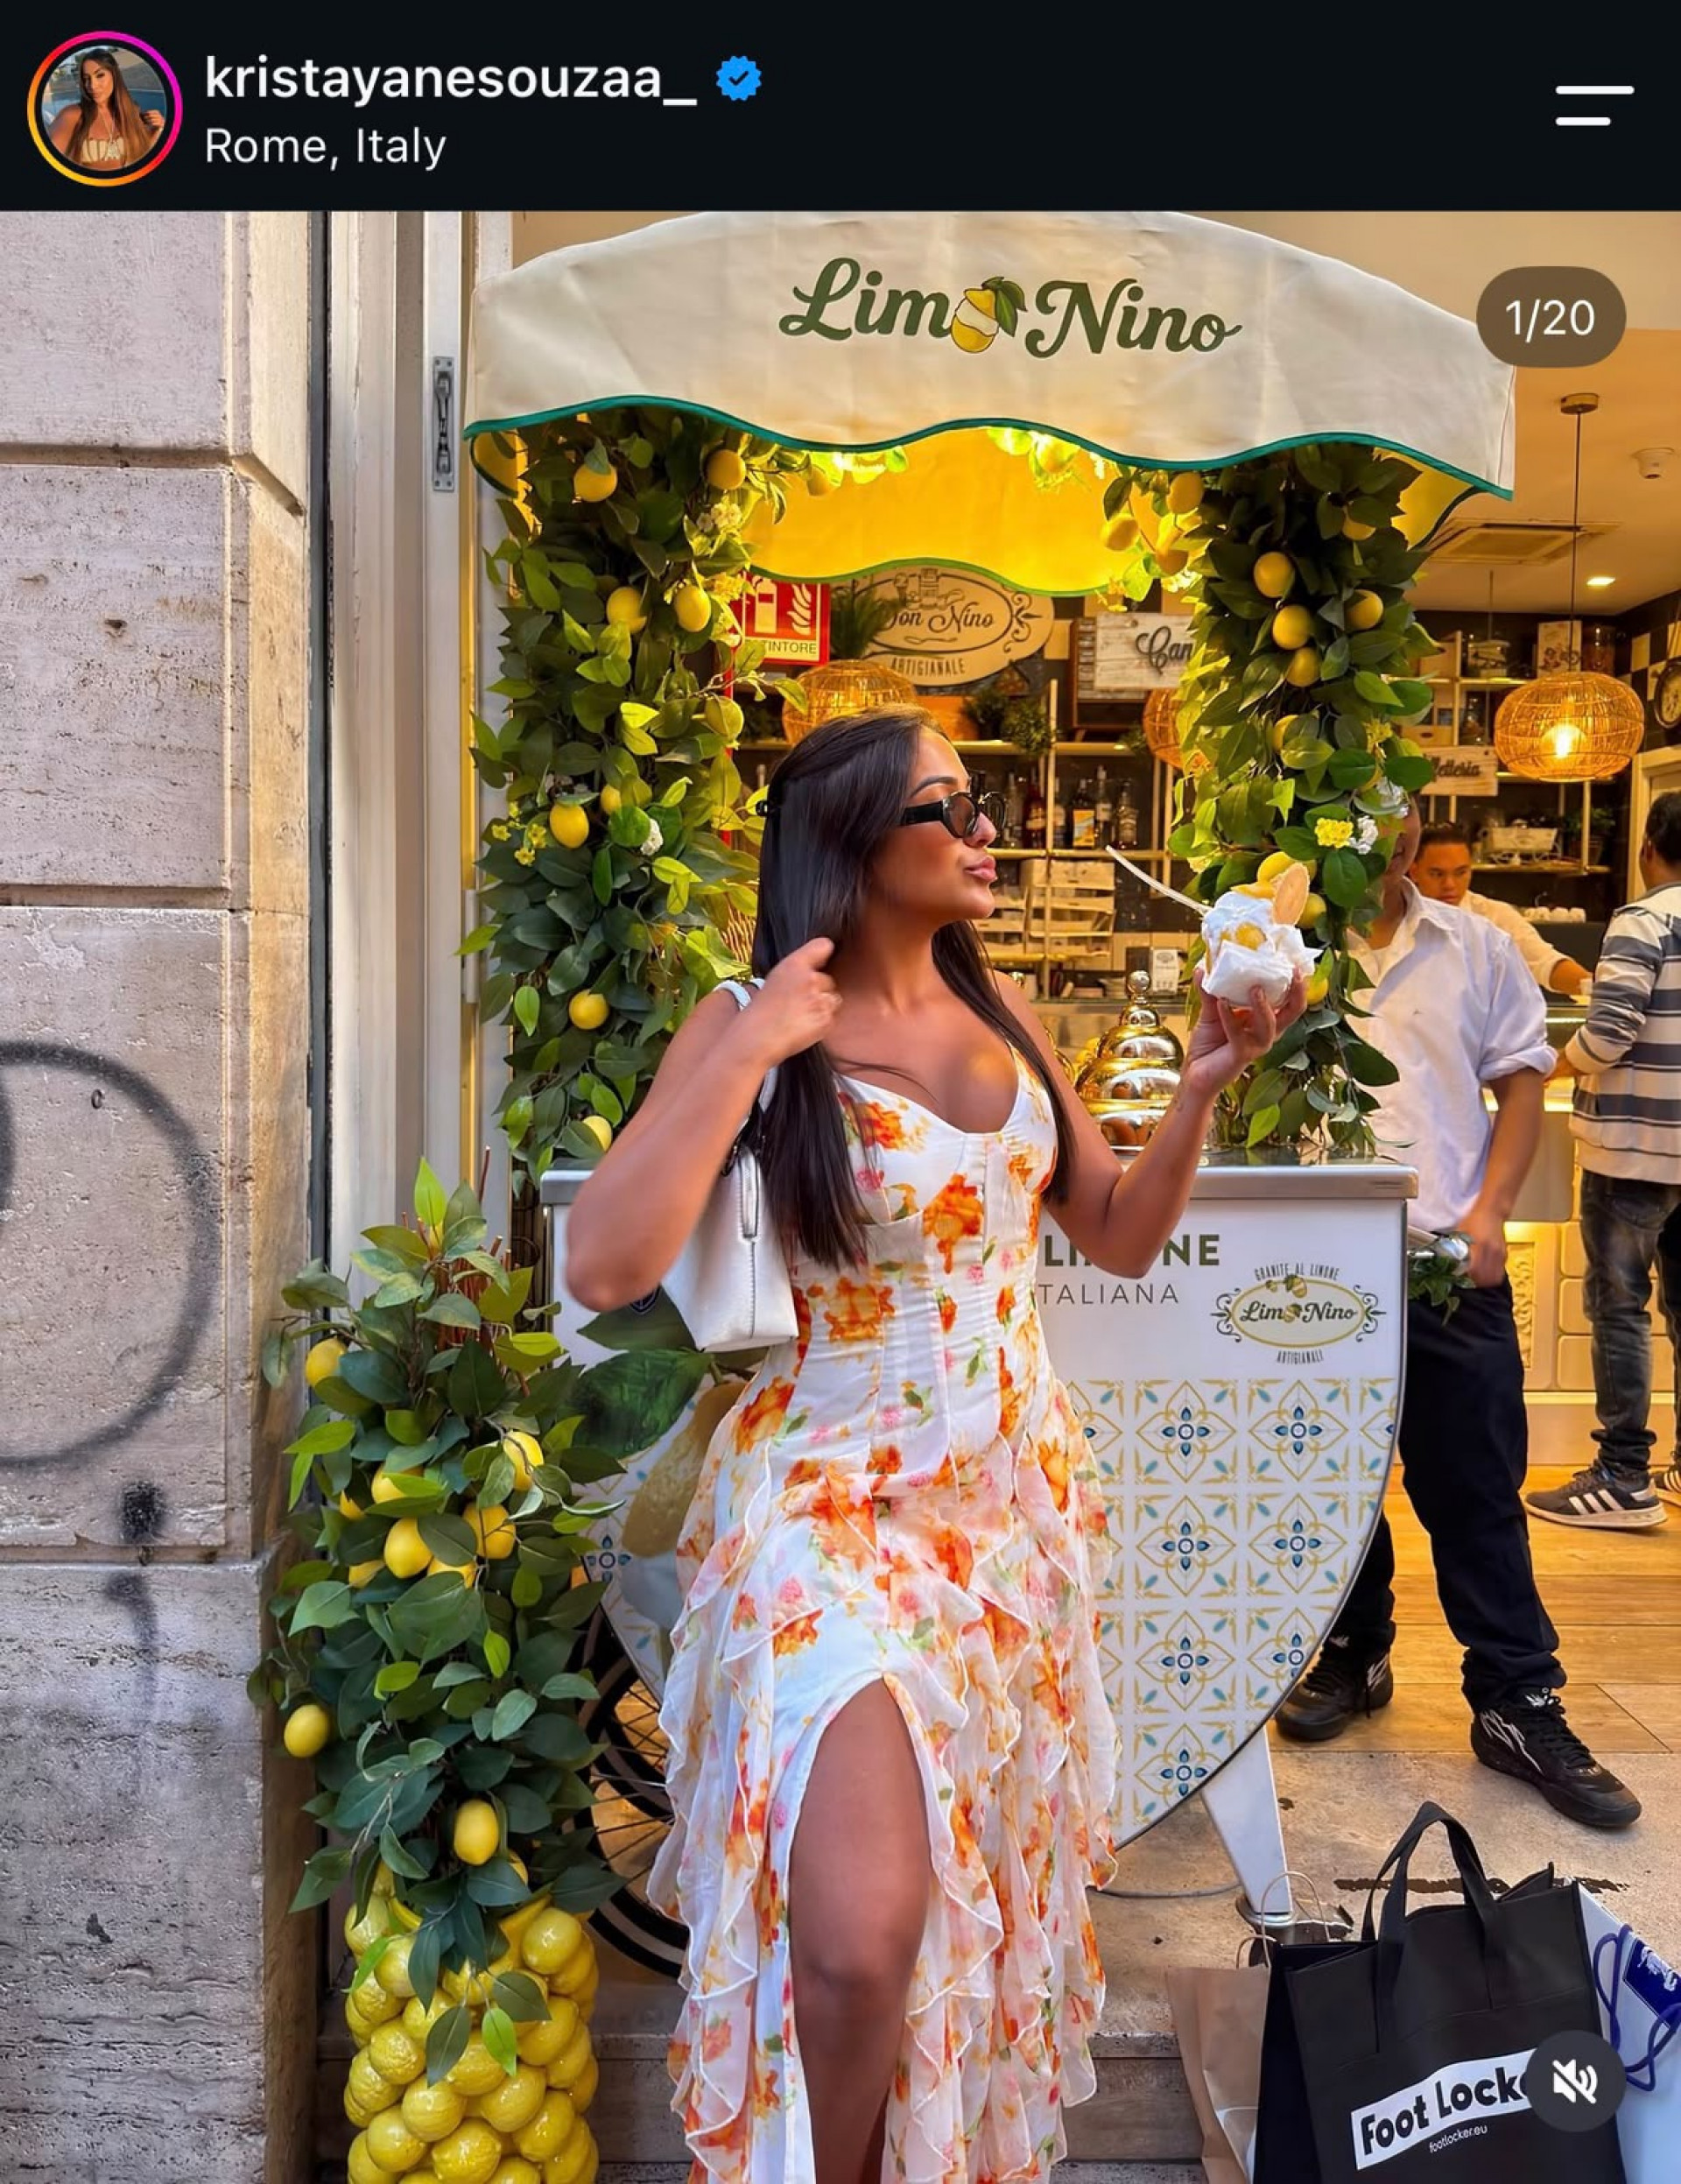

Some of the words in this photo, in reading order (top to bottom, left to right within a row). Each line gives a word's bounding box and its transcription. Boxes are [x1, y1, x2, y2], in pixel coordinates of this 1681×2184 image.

[928, 601, 994, 633] Nino
[891, 659, 965, 676] ARTIGIANALE
[1044, 1234, 1220, 1266] LINE
[1310, 1264, 1340, 1280] LIMONE
[1037, 1283, 1179, 1305] TALIANA
[1361, 2096, 1430, 2156] Foot
[1435, 2067, 1528, 2119] Lock
[1429, 2124, 1488, 2154] footlocker.eu
